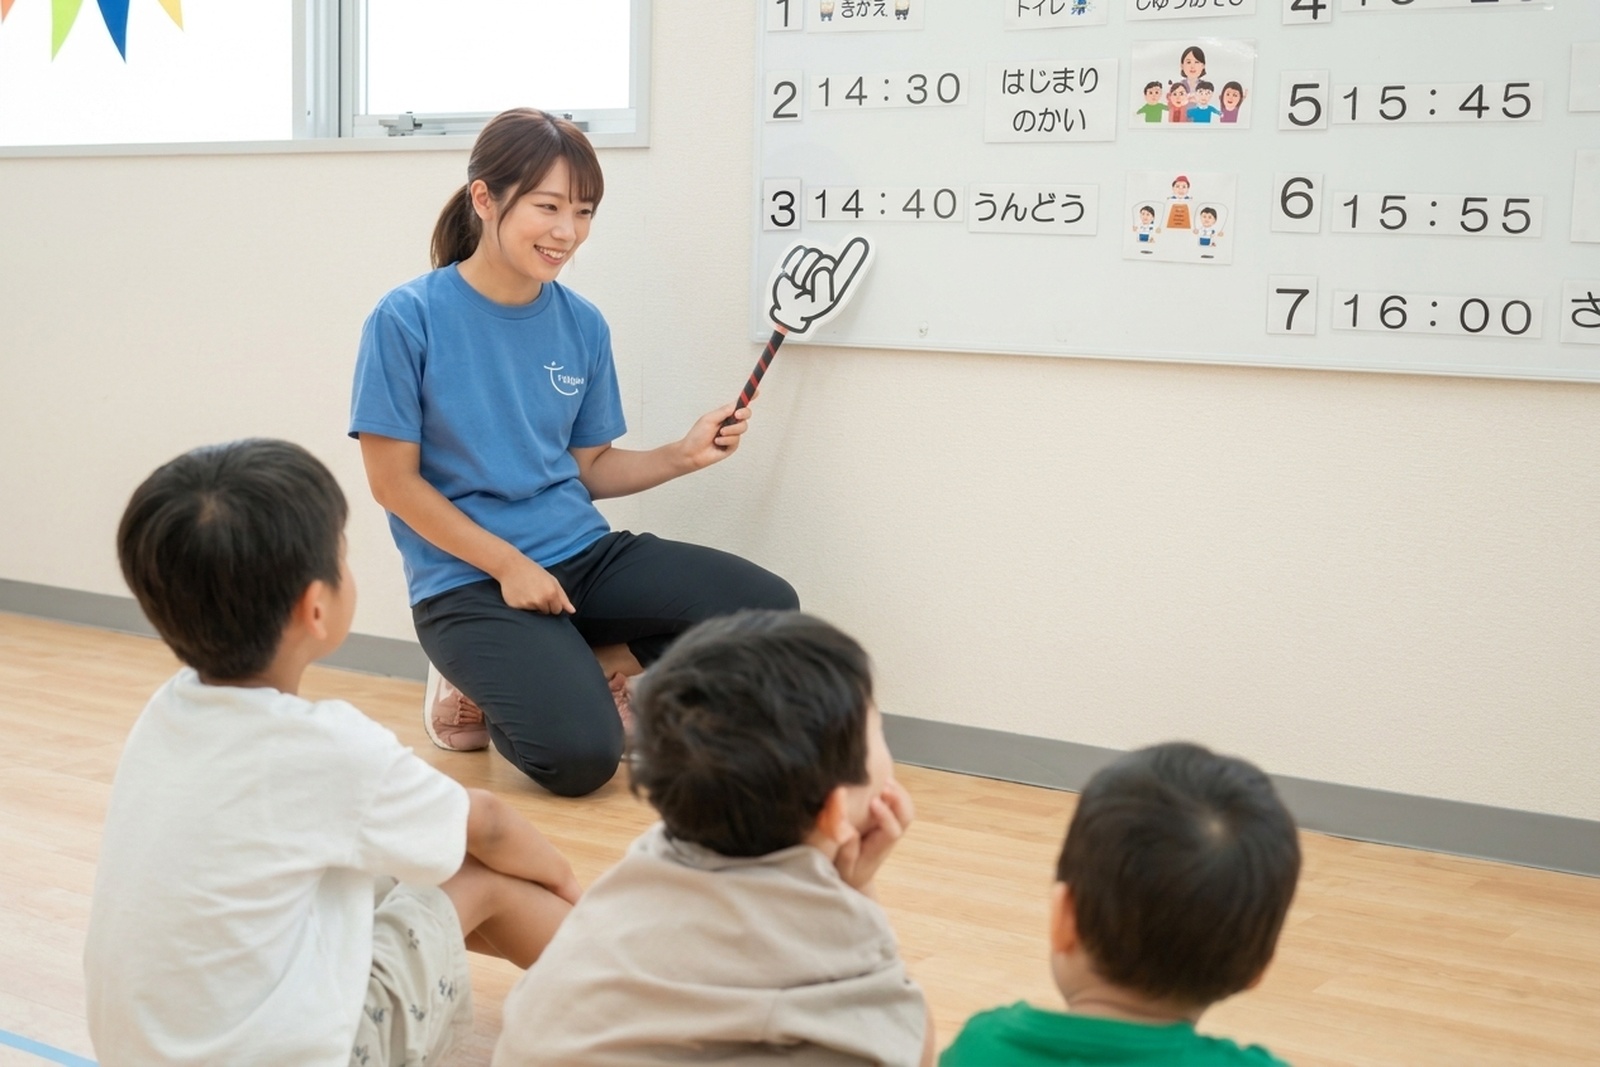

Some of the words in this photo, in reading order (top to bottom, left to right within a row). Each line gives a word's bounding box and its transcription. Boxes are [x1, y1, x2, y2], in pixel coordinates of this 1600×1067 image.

[774, 0, 791, 28] 1
[772, 80, 799, 119] 2
[818, 73, 962, 107] 14:30
[1001, 66, 1100, 96] はじまり
[1012, 107, 1087, 133] のかい
[1287, 82, 1322, 127] 5
[1342, 82, 1532, 121] 15:45
[769, 190, 796, 228] 3
[814, 188, 958, 220] 14:40
[974, 192, 1085, 224] うんどう
[1280, 176, 1314, 220] 6
[1343, 194, 1532, 235] 15:55
[1275, 287, 1310, 331] 7
[1343, 293, 1532, 336] 16:00
